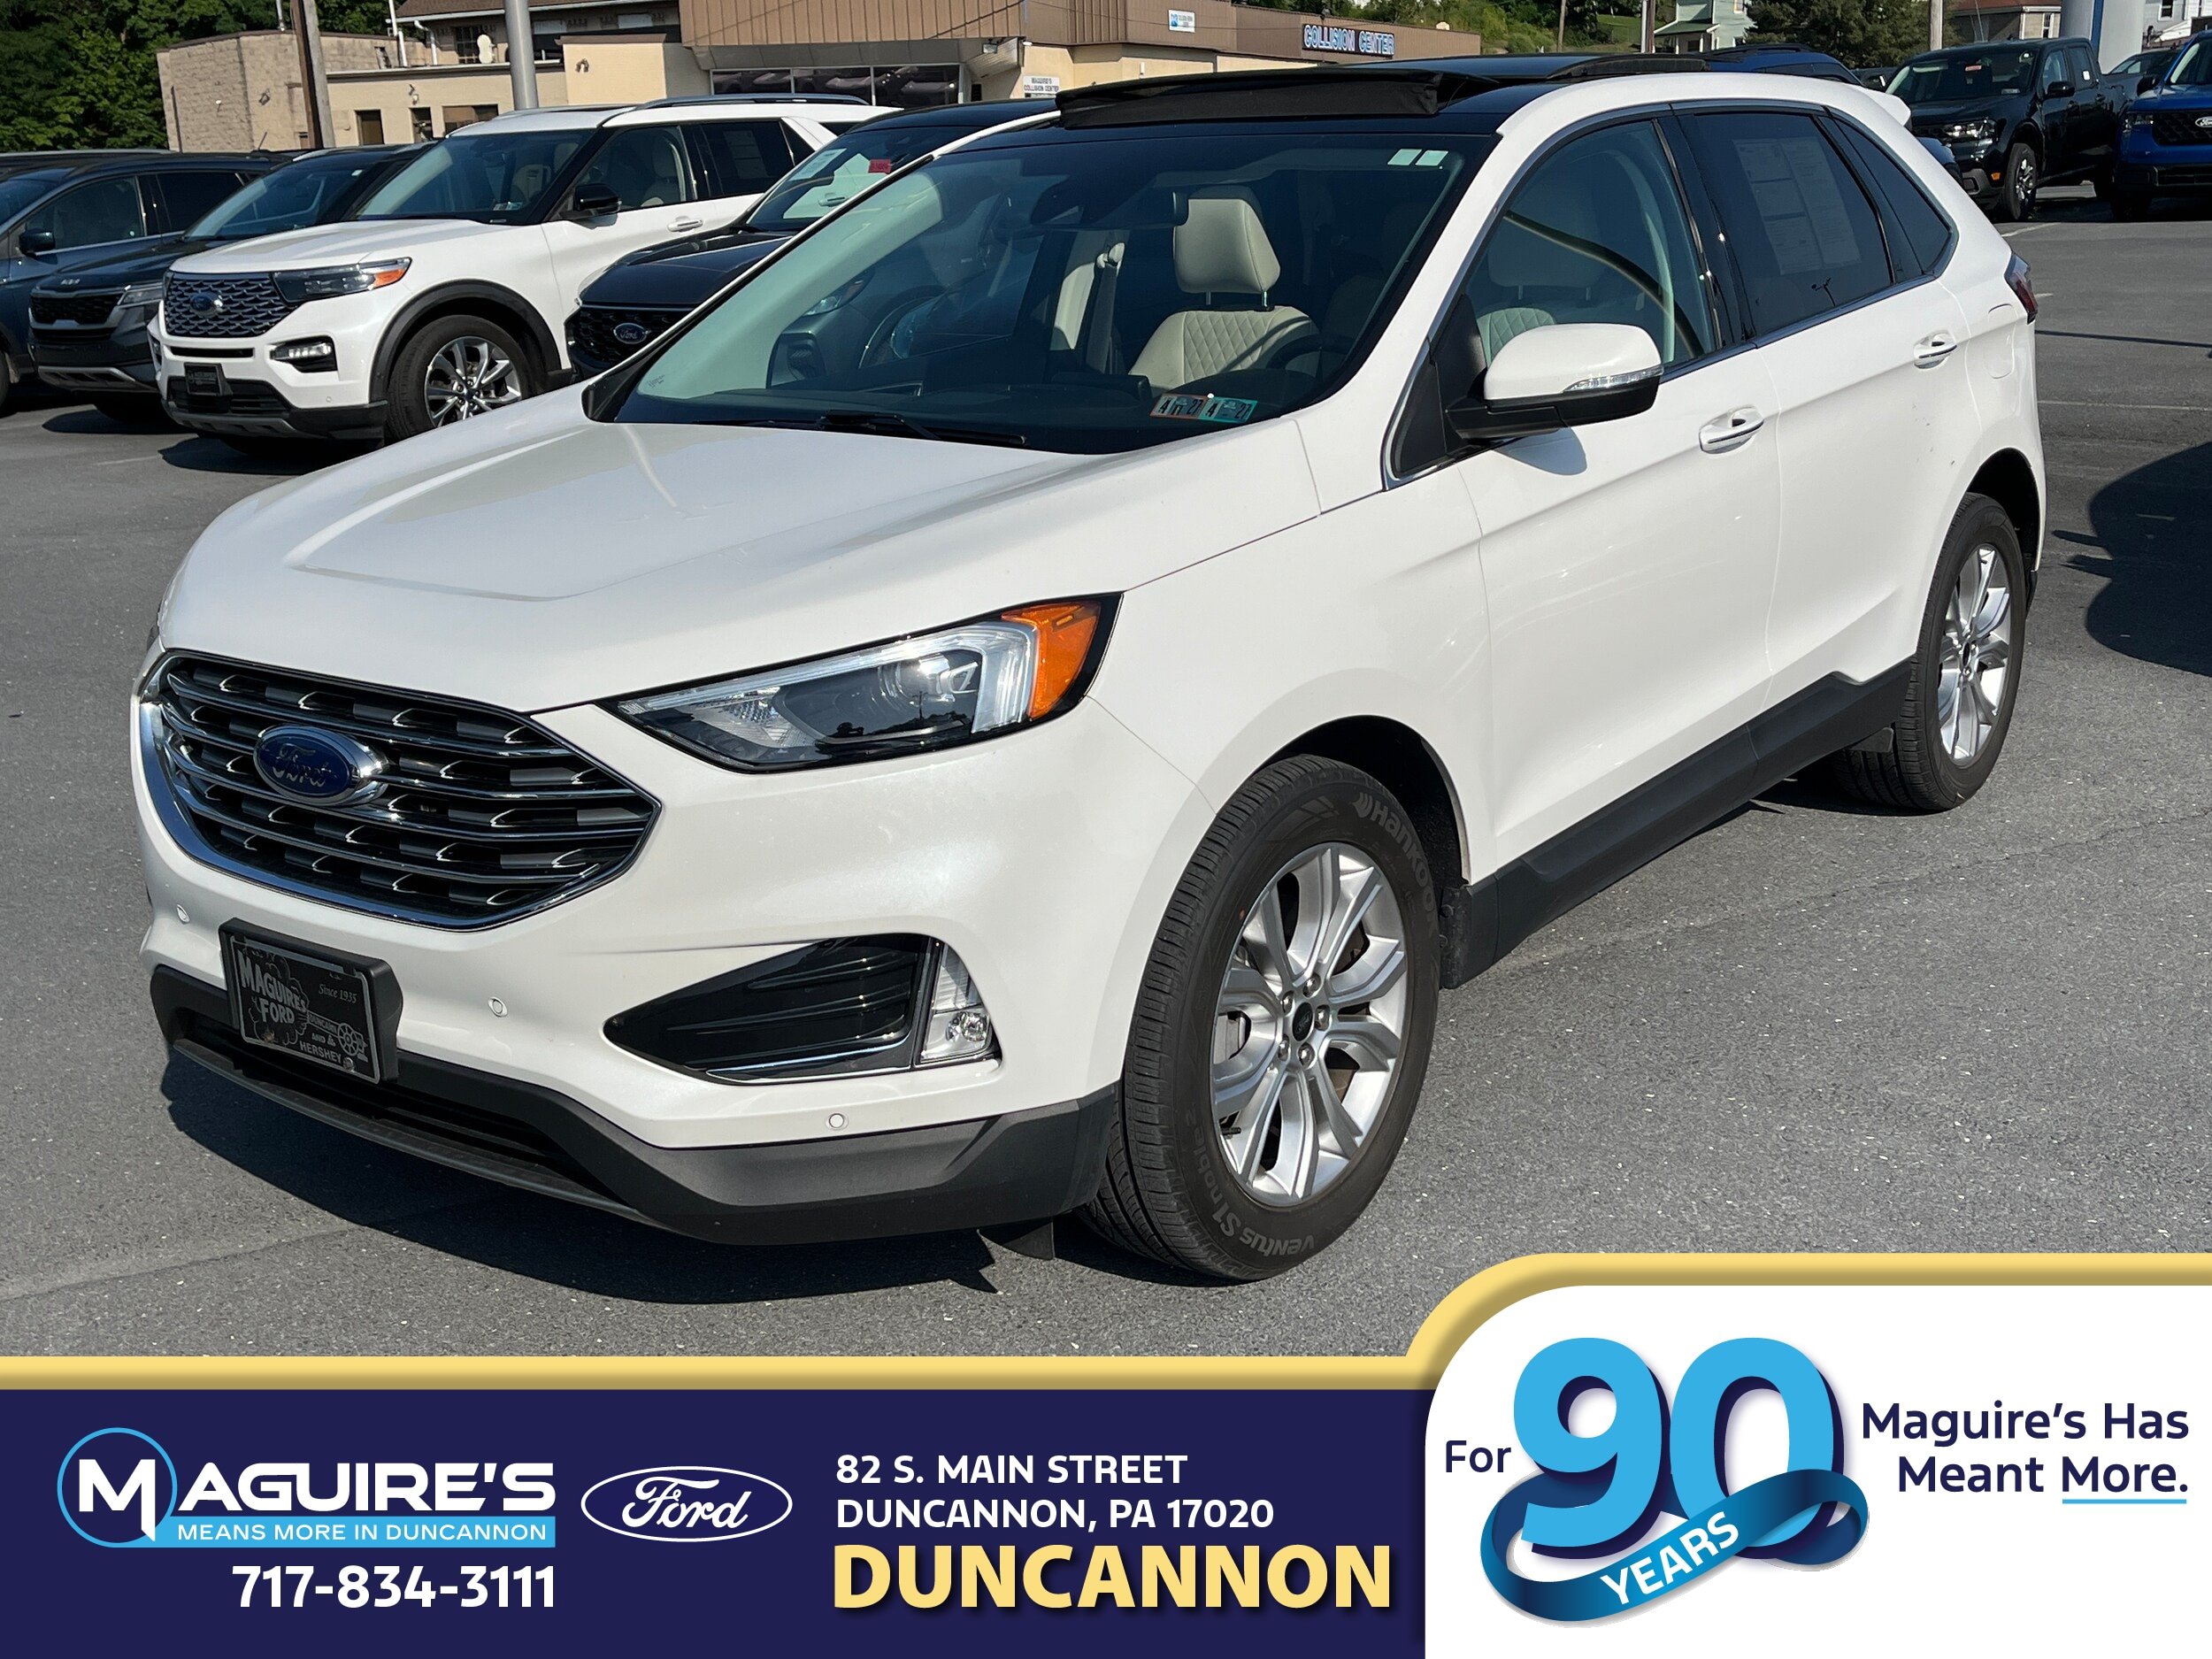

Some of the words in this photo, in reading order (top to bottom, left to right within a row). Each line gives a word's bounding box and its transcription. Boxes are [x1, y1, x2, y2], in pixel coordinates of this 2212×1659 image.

[1303, 24, 1356, 51] COLLISION
[1358, 30, 1395, 55] CENTER
[1186, 399, 1204, 415] 27
[1234, 403, 1253, 419] 27
[273, 742, 340, 787] Ford
[318, 983, 339, 1000] Since
[340, 988, 357, 1004] 1935
[259, 997, 296, 1024] FORD
[299, 1041, 342, 1064] HERSHEY
